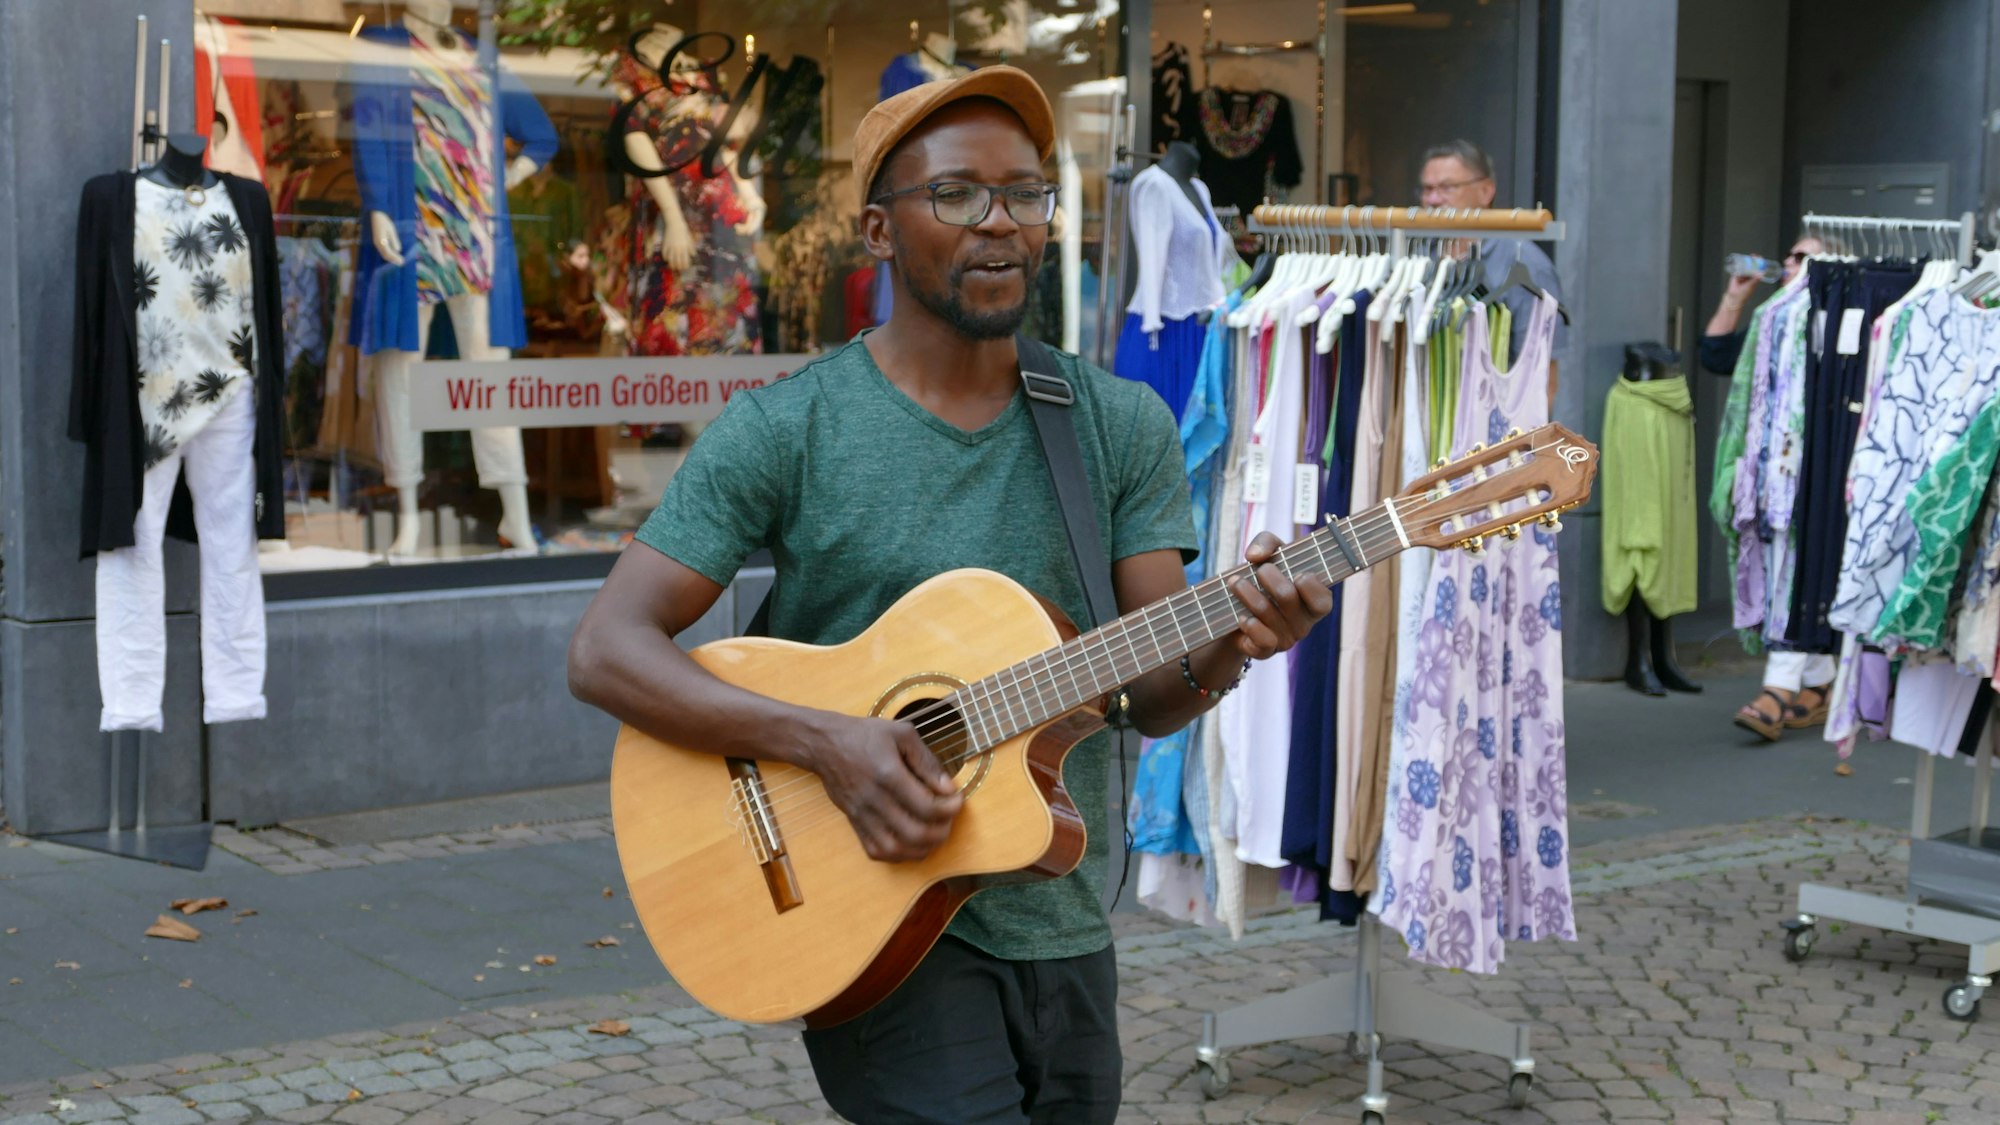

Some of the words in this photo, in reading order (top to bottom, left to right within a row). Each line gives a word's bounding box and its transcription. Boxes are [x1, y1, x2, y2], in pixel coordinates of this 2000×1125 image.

[446, 377, 496, 410] Wir
[507, 375, 600, 409] führen
[612, 373, 709, 407] Größen
